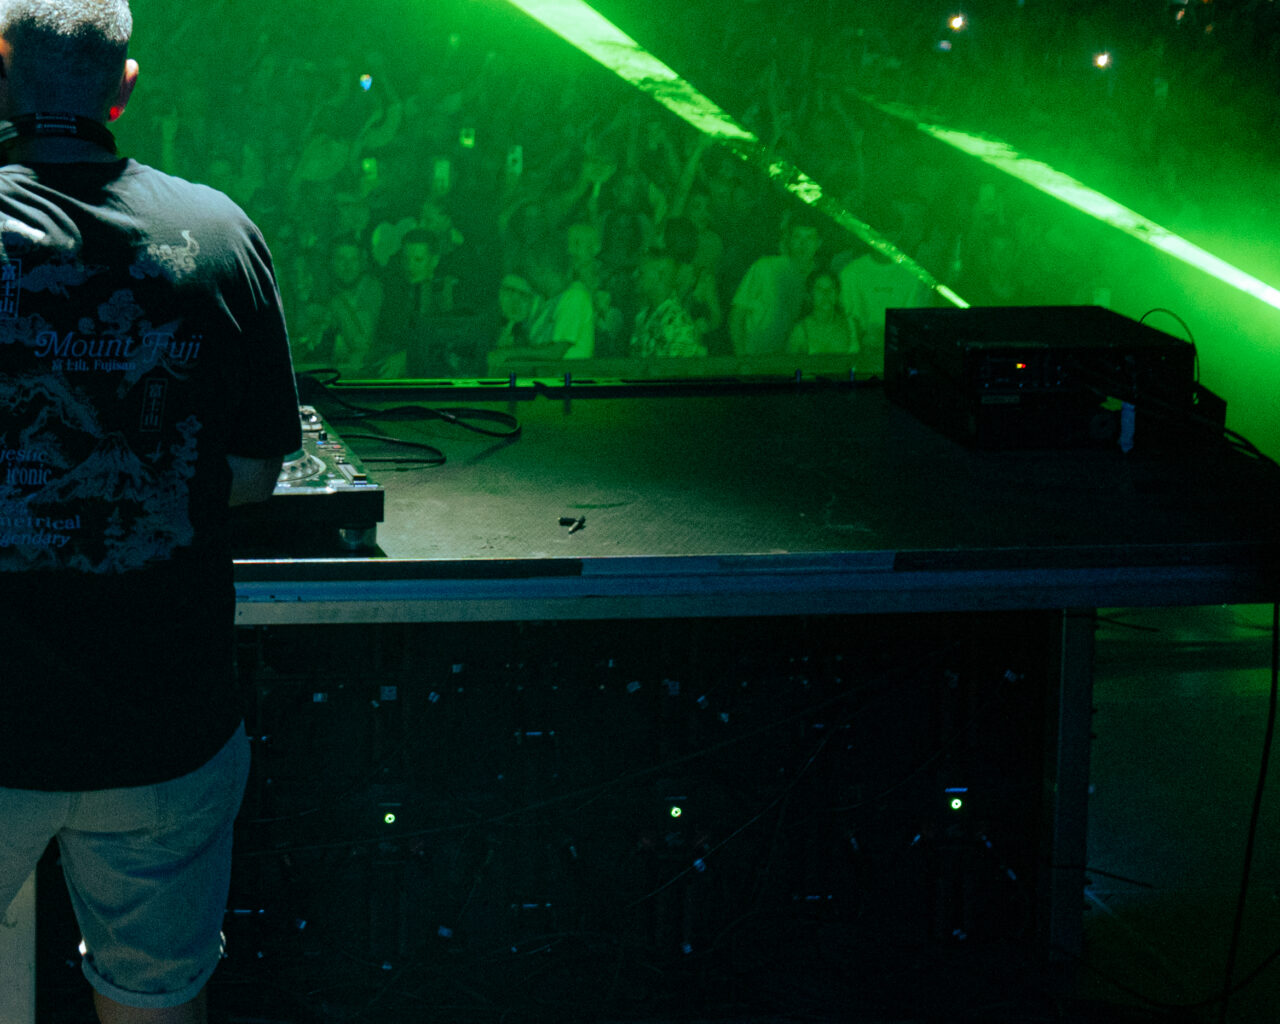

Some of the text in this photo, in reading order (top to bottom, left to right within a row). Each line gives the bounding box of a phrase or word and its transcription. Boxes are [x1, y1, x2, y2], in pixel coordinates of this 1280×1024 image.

[0, 262, 17, 314] 富士山
[34, 330, 205, 365] Mount Fuji
[94, 359, 137, 373] Fujisan
